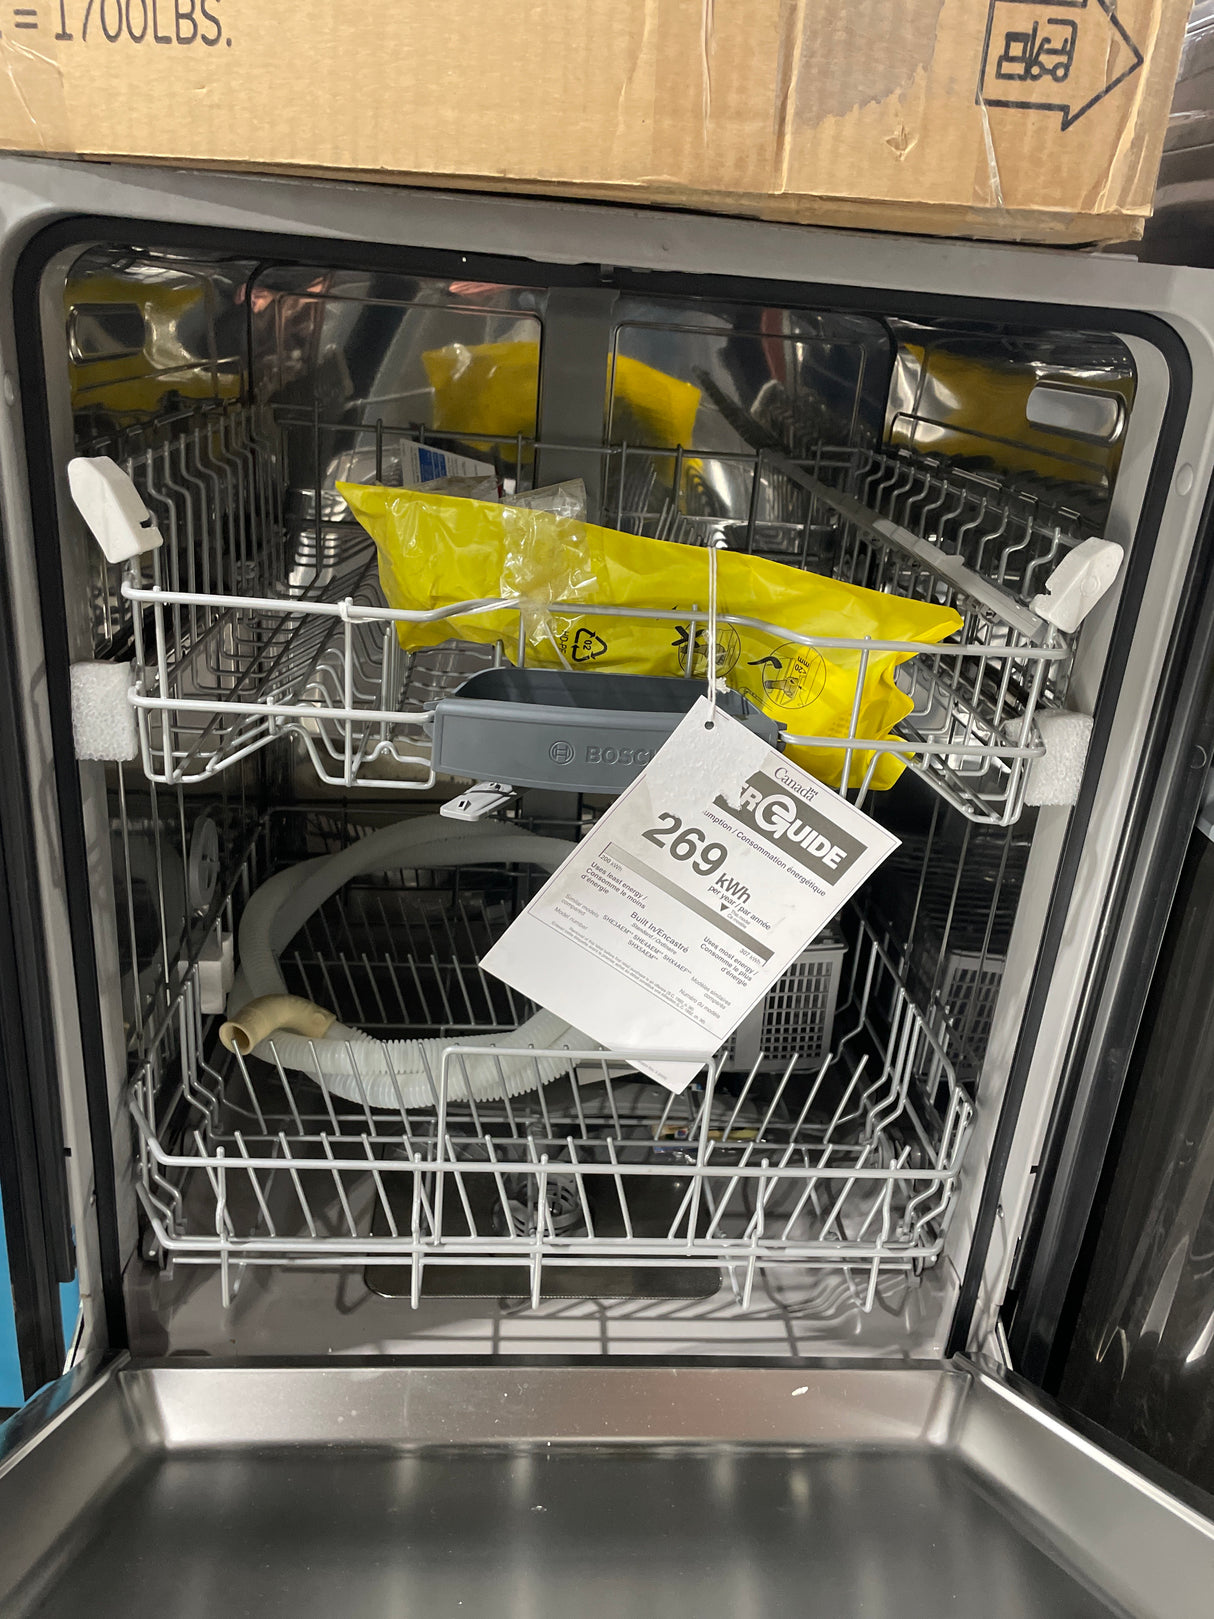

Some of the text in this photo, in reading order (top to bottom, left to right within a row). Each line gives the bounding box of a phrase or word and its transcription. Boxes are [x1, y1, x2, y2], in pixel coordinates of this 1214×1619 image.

[582, 639, 593, 651] 02
[585, 745, 659, 767] BOSC
[774, 767, 818, 801] Canada
[740, 784, 848, 871] RGUIDE
[640, 811, 750, 903] 269 kWh
[703, 810, 732, 831] umption
[736, 831, 786, 868] Consommation
[786, 866, 825, 896] énergétique
[580, 874, 609, 893] d'énergie
[585, 867, 620, 892] Consomme
[626, 894, 645, 909] moins
[590, 861, 606, 874] Uses
[606, 871, 622, 884] least
[621, 882, 643, 898] energy
[707, 885, 721, 894] per
[719, 893, 736, 905] year
[737, 906, 751, 915] par
[749, 914, 770, 930] année
[630, 911, 688, 953] Built In/Encastré
[700, 943, 732, 968] Consomme
[737, 970, 752, 981] plus
[703, 935, 718, 949] Uses
[718, 947, 734, 960] most
[733, 958, 754, 974] energy
[720, 966, 747, 986] d'énergie
